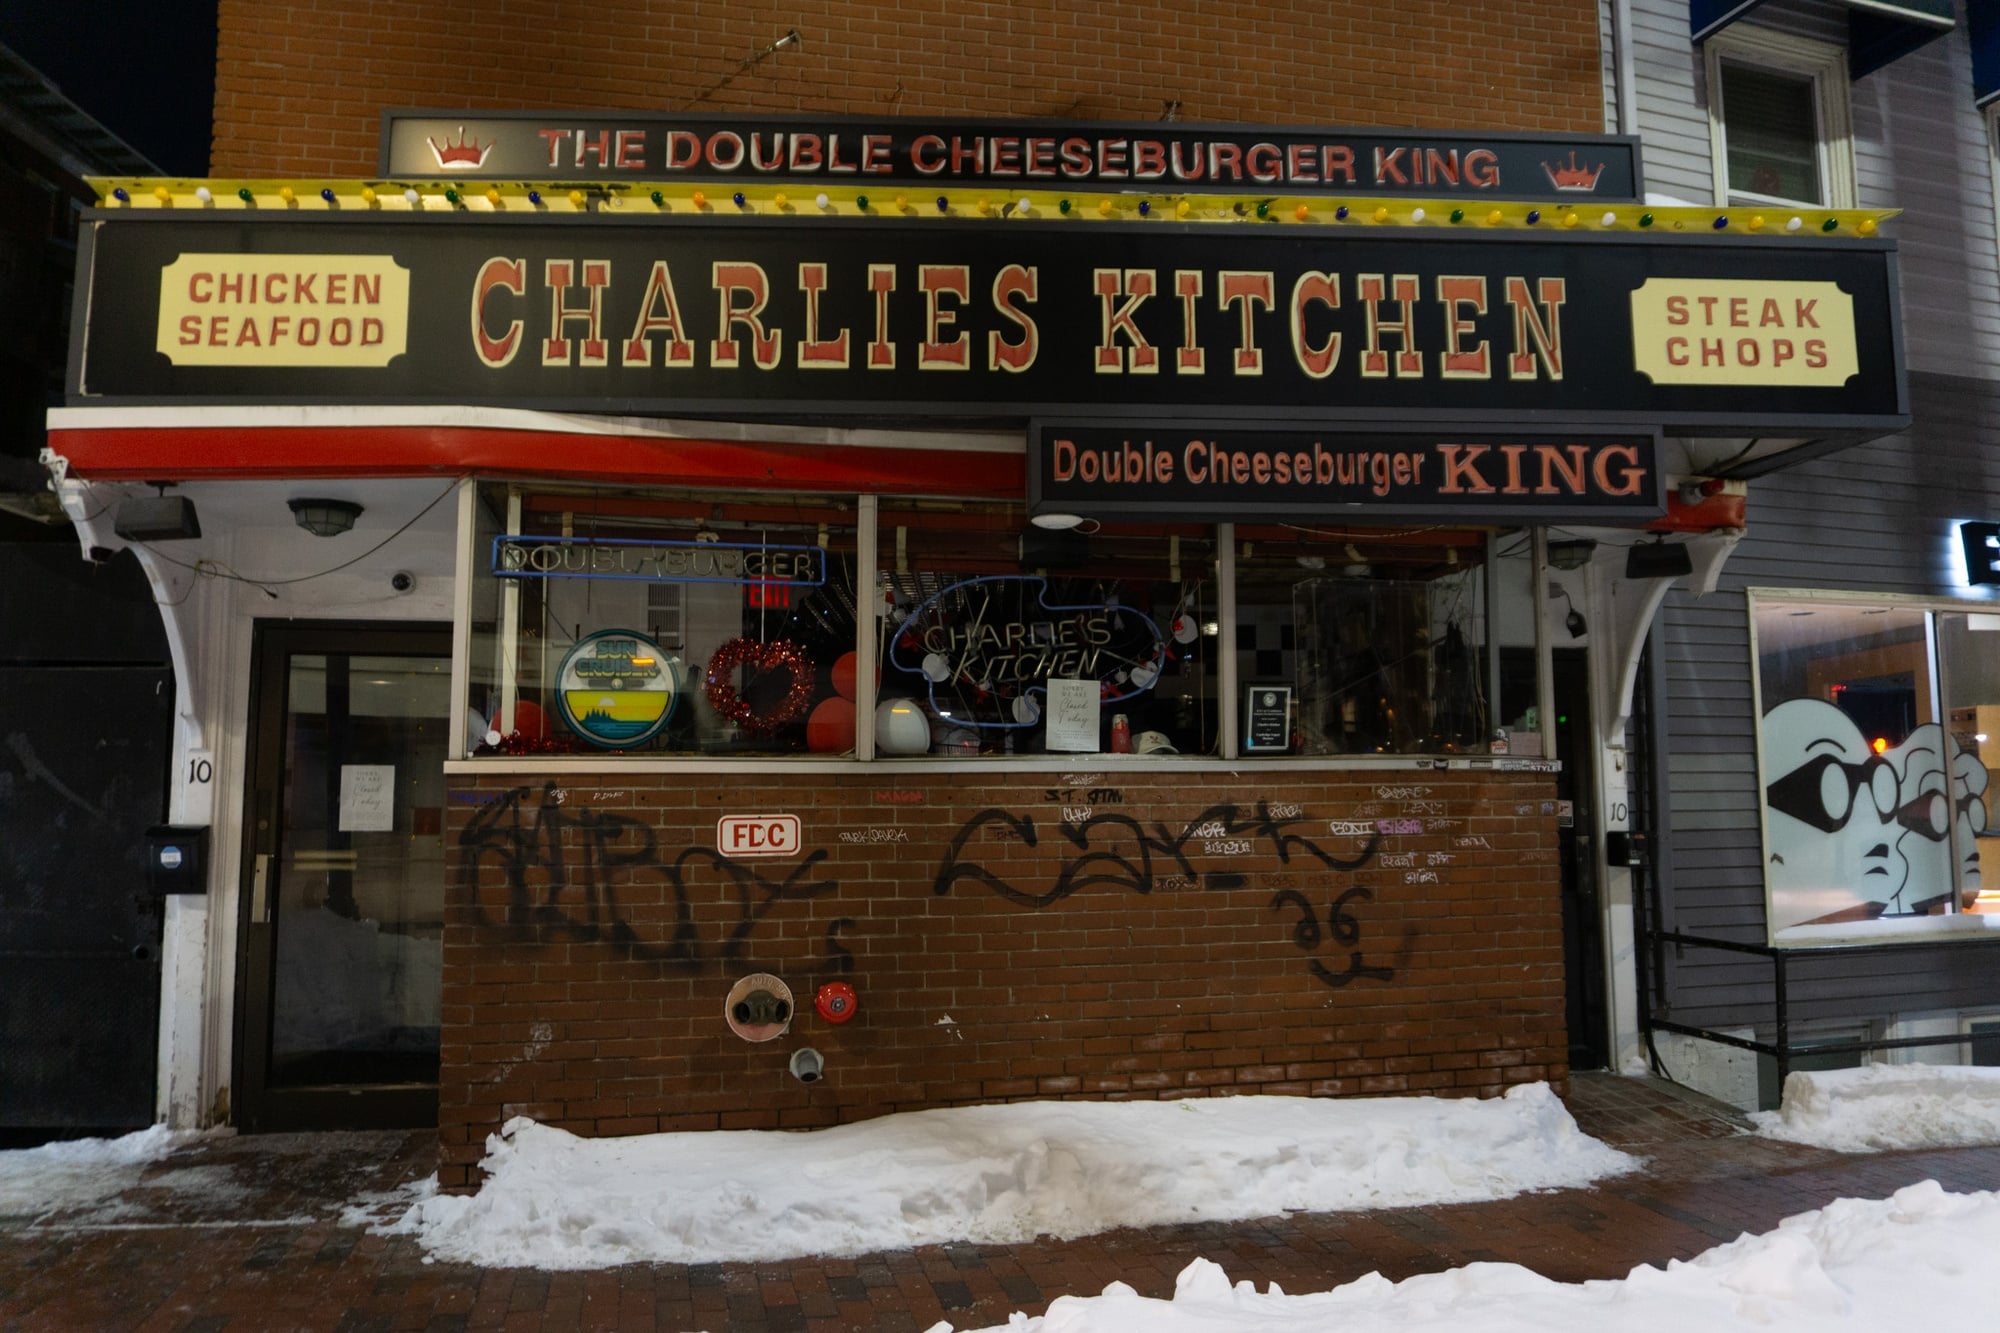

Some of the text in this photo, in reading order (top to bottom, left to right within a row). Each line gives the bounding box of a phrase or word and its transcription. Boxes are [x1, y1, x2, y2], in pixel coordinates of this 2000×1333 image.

[538, 129, 1501, 188] THE DOUBLE CHEESEBURGER KING
[188, 272, 381, 305] CHICKEN
[471, 256, 1567, 381] CHARLIES KITCHEN
[1666, 296, 1820, 329] STEAK
[179, 316, 385, 347] SEAFOOD
[1666, 337, 1829, 368] CHOPS
[1052, 439, 1648, 497] Double Cheeseburger KING
[749, 576, 790, 607] EXIT
[596, 640, 637, 658] SUN
[924, 617, 1112, 653] CHARLIE'S
[952, 648, 1100, 686] KITCHEN
[190, 758, 212, 784] 10
[1610, 803, 1628, 821] 10
[733, 823, 786, 848] FDC
